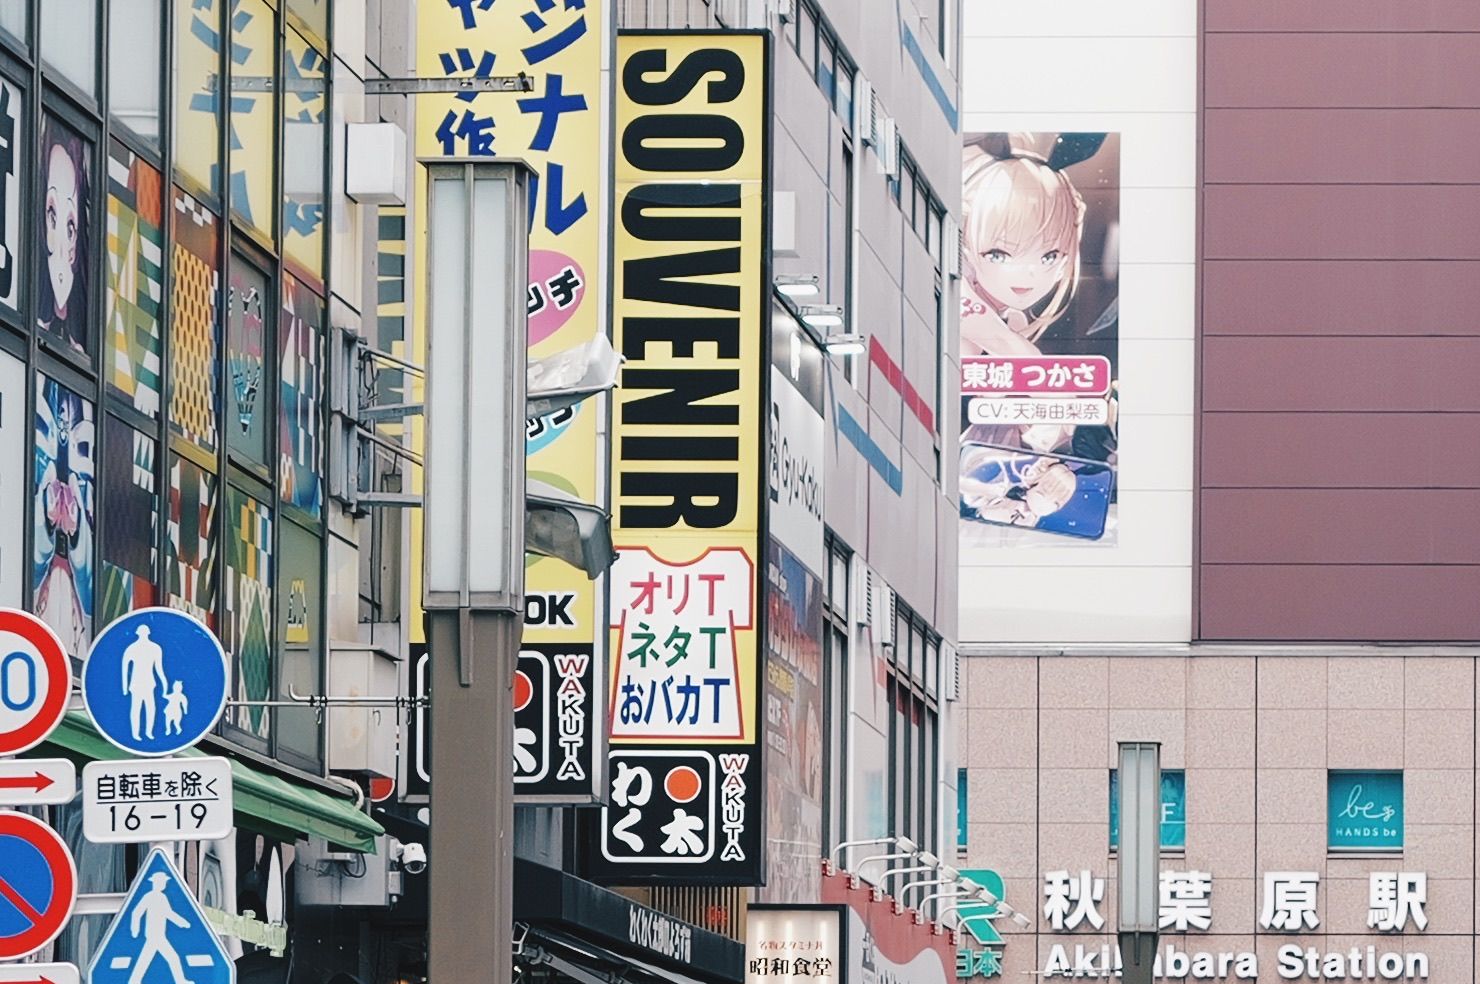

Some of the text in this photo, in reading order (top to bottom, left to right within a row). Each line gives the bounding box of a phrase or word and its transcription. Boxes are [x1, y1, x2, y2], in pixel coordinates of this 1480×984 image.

[621, 47, 745, 528] SOUVENIR
[962, 362, 1096, 388] 東城 つかさ
[629, 571, 726, 616] オリT
[627, 625, 726, 669] ネタT
[556, 656, 588, 779] WAKUTA
[620, 674, 730, 724] おバカT
[97, 771, 218, 799] 自転車を除く
[108, 803, 207, 832] 16-19
[721, 755, 748, 861] WAKUTA
[1336, 827, 1378, 837] HANDS
[1043, 870, 1429, 931] 秋葉原駅
[750, 957, 832, 978] 昭和食堂
[1277, 945, 1430, 979] Station
